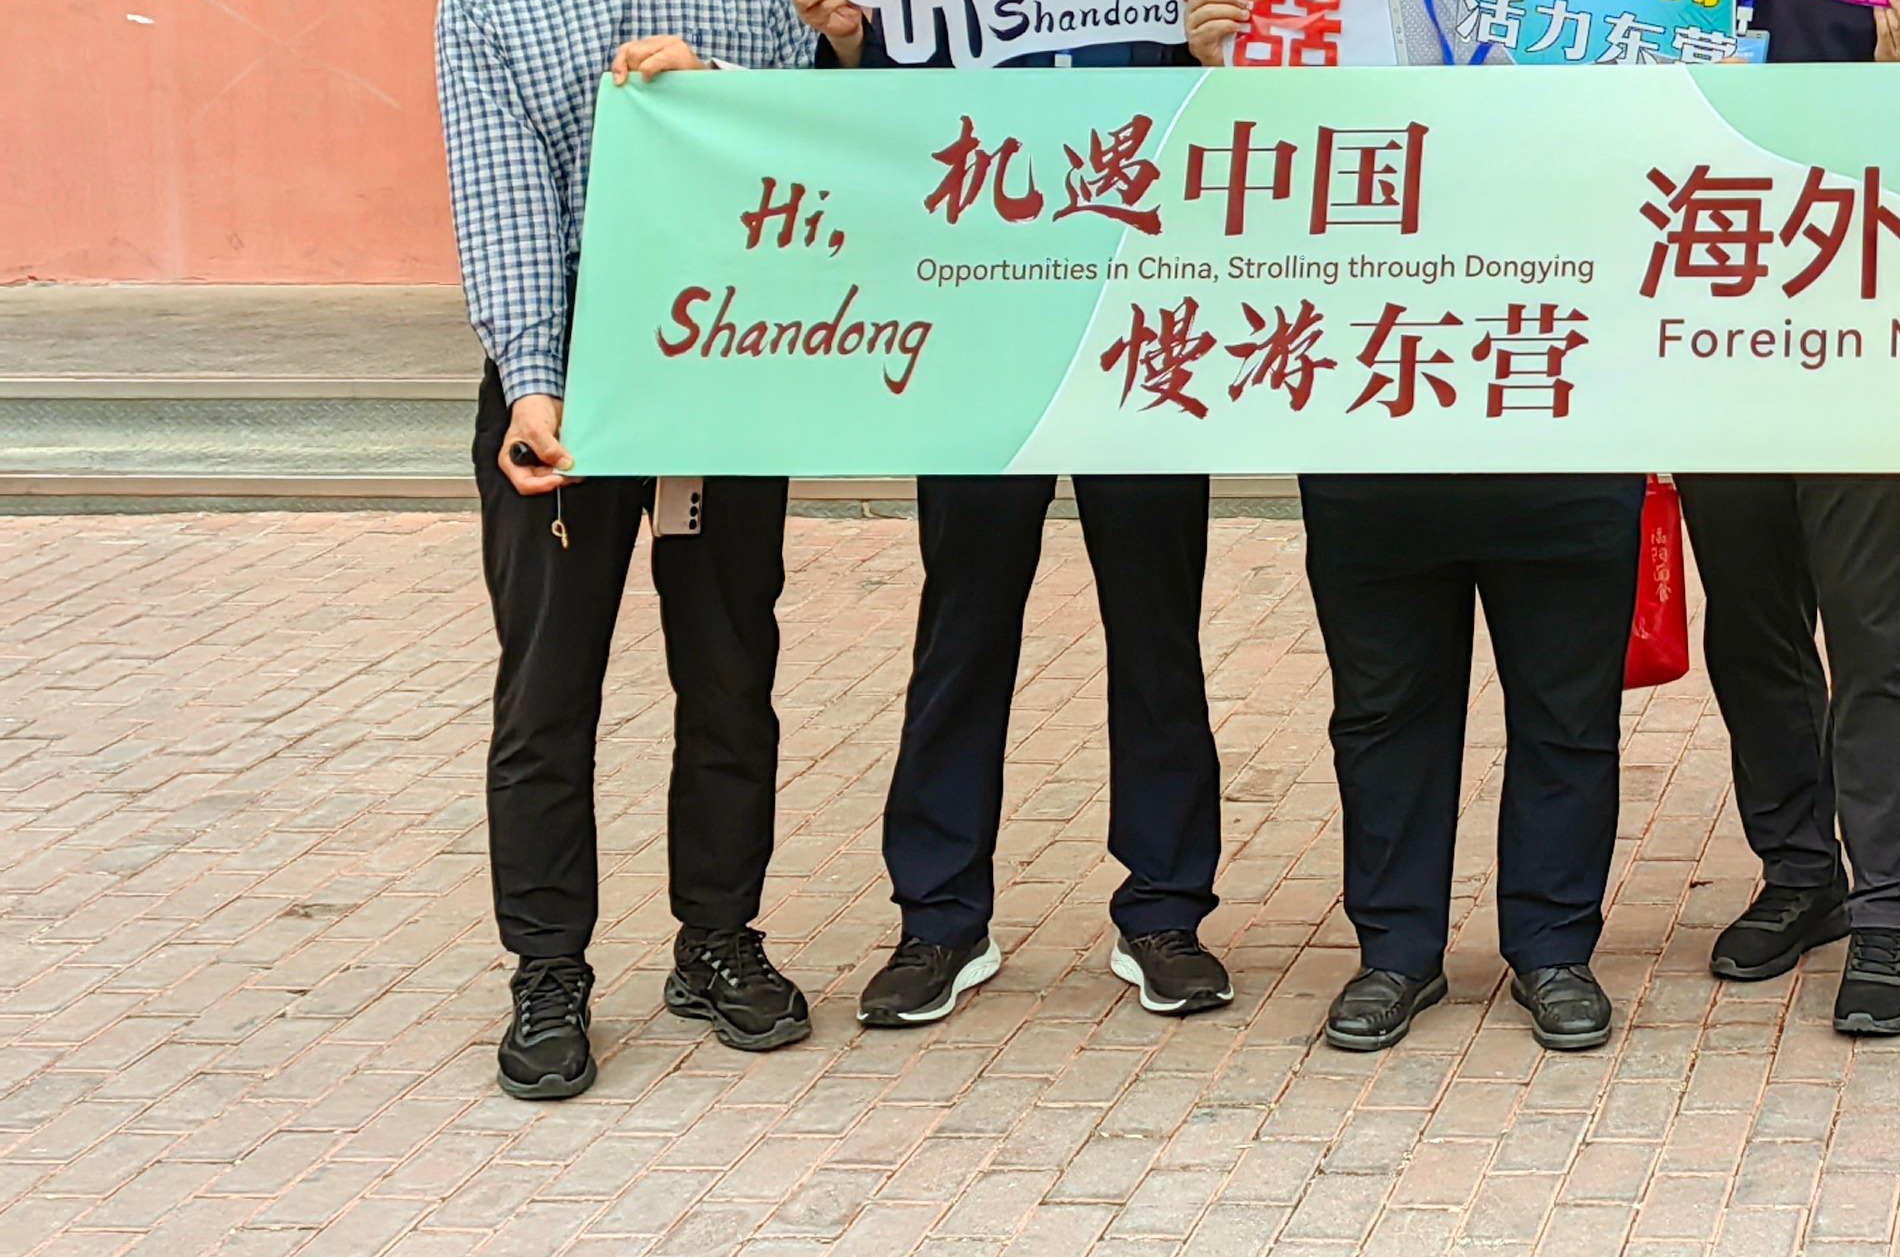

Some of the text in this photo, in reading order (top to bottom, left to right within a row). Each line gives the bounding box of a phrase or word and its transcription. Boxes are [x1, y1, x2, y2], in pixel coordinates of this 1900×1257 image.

[740, 176, 846, 257] Hi,
[924, 113, 1430, 236] 机遇中国
[917, 253, 1595, 288] Opportunities in China, Strolling through Dongying
[656, 284, 933, 395] Shandong
[1100, 296, 1590, 420] 慢游东营
[1657, 317, 1863, 372] Foreign
